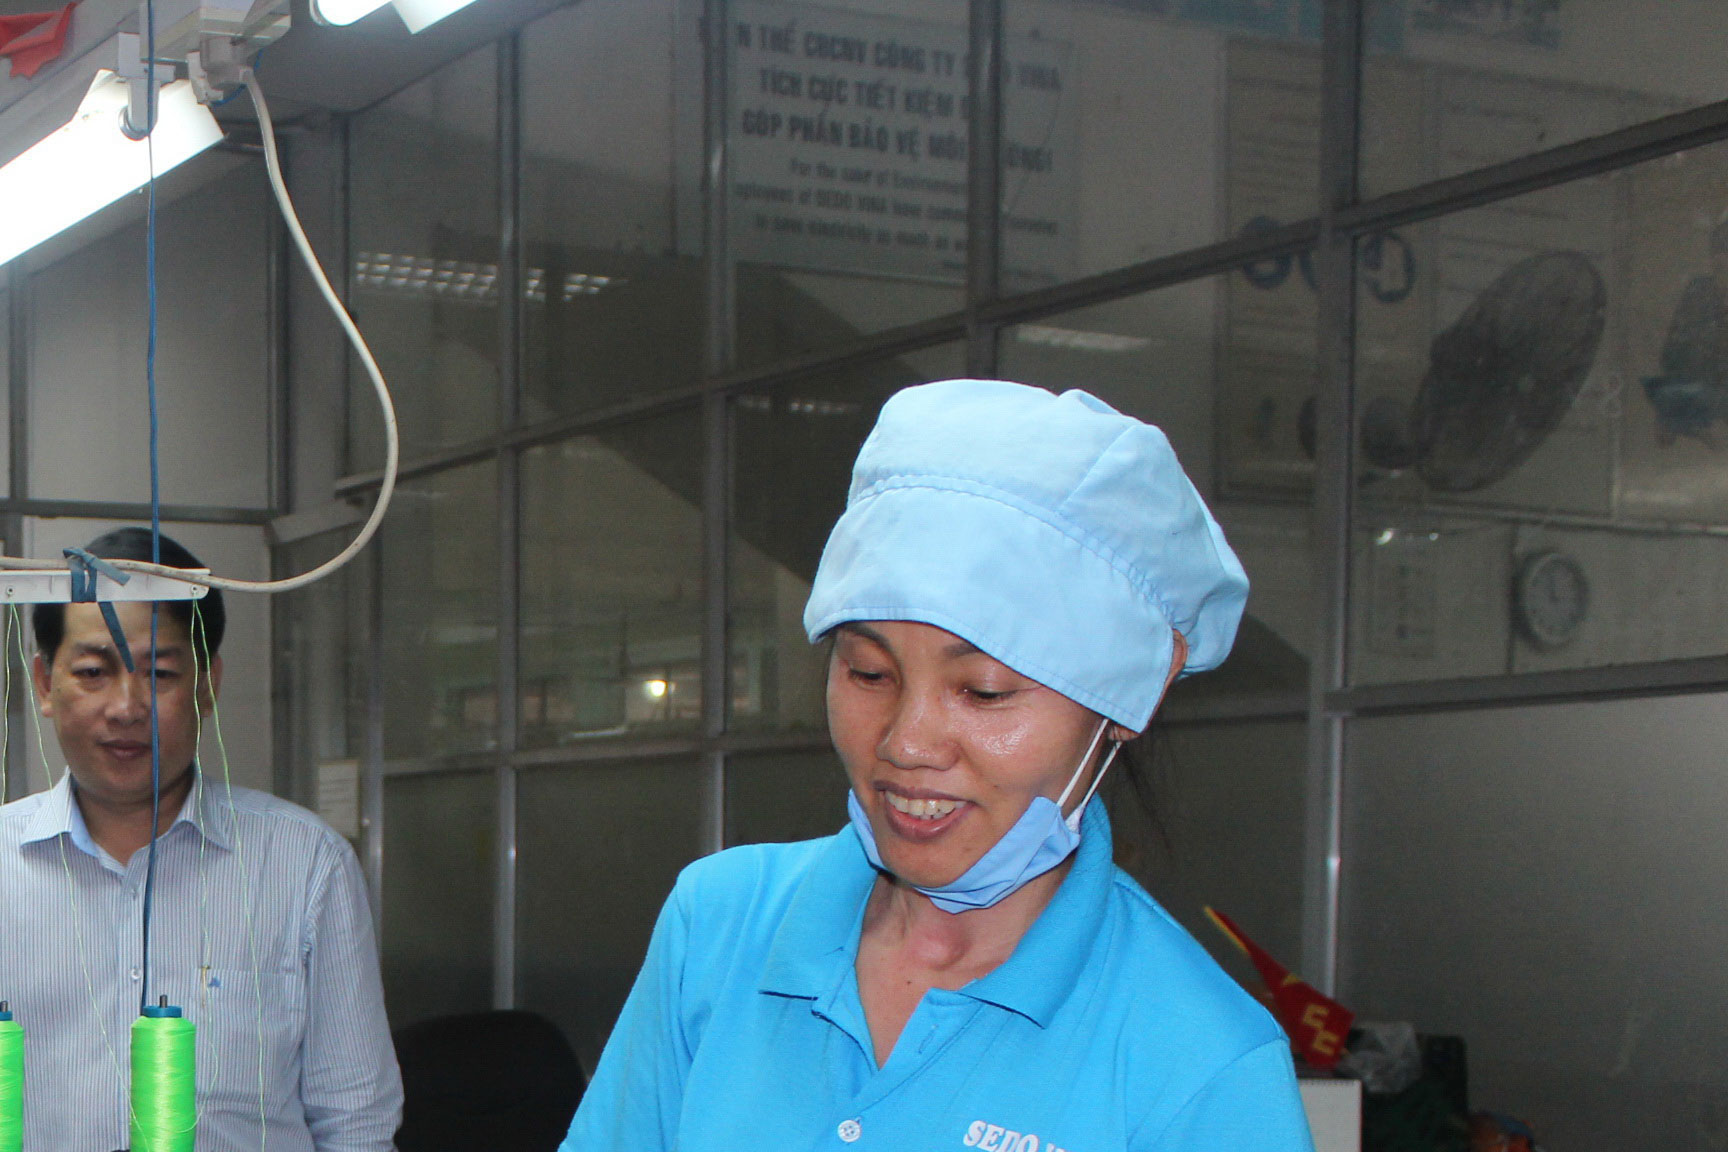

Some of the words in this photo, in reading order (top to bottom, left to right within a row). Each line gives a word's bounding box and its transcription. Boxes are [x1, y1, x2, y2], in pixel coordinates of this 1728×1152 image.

[932, 49, 955, 77] TY
[816, 161, 838, 181] the
[799, 187, 813, 206] of
